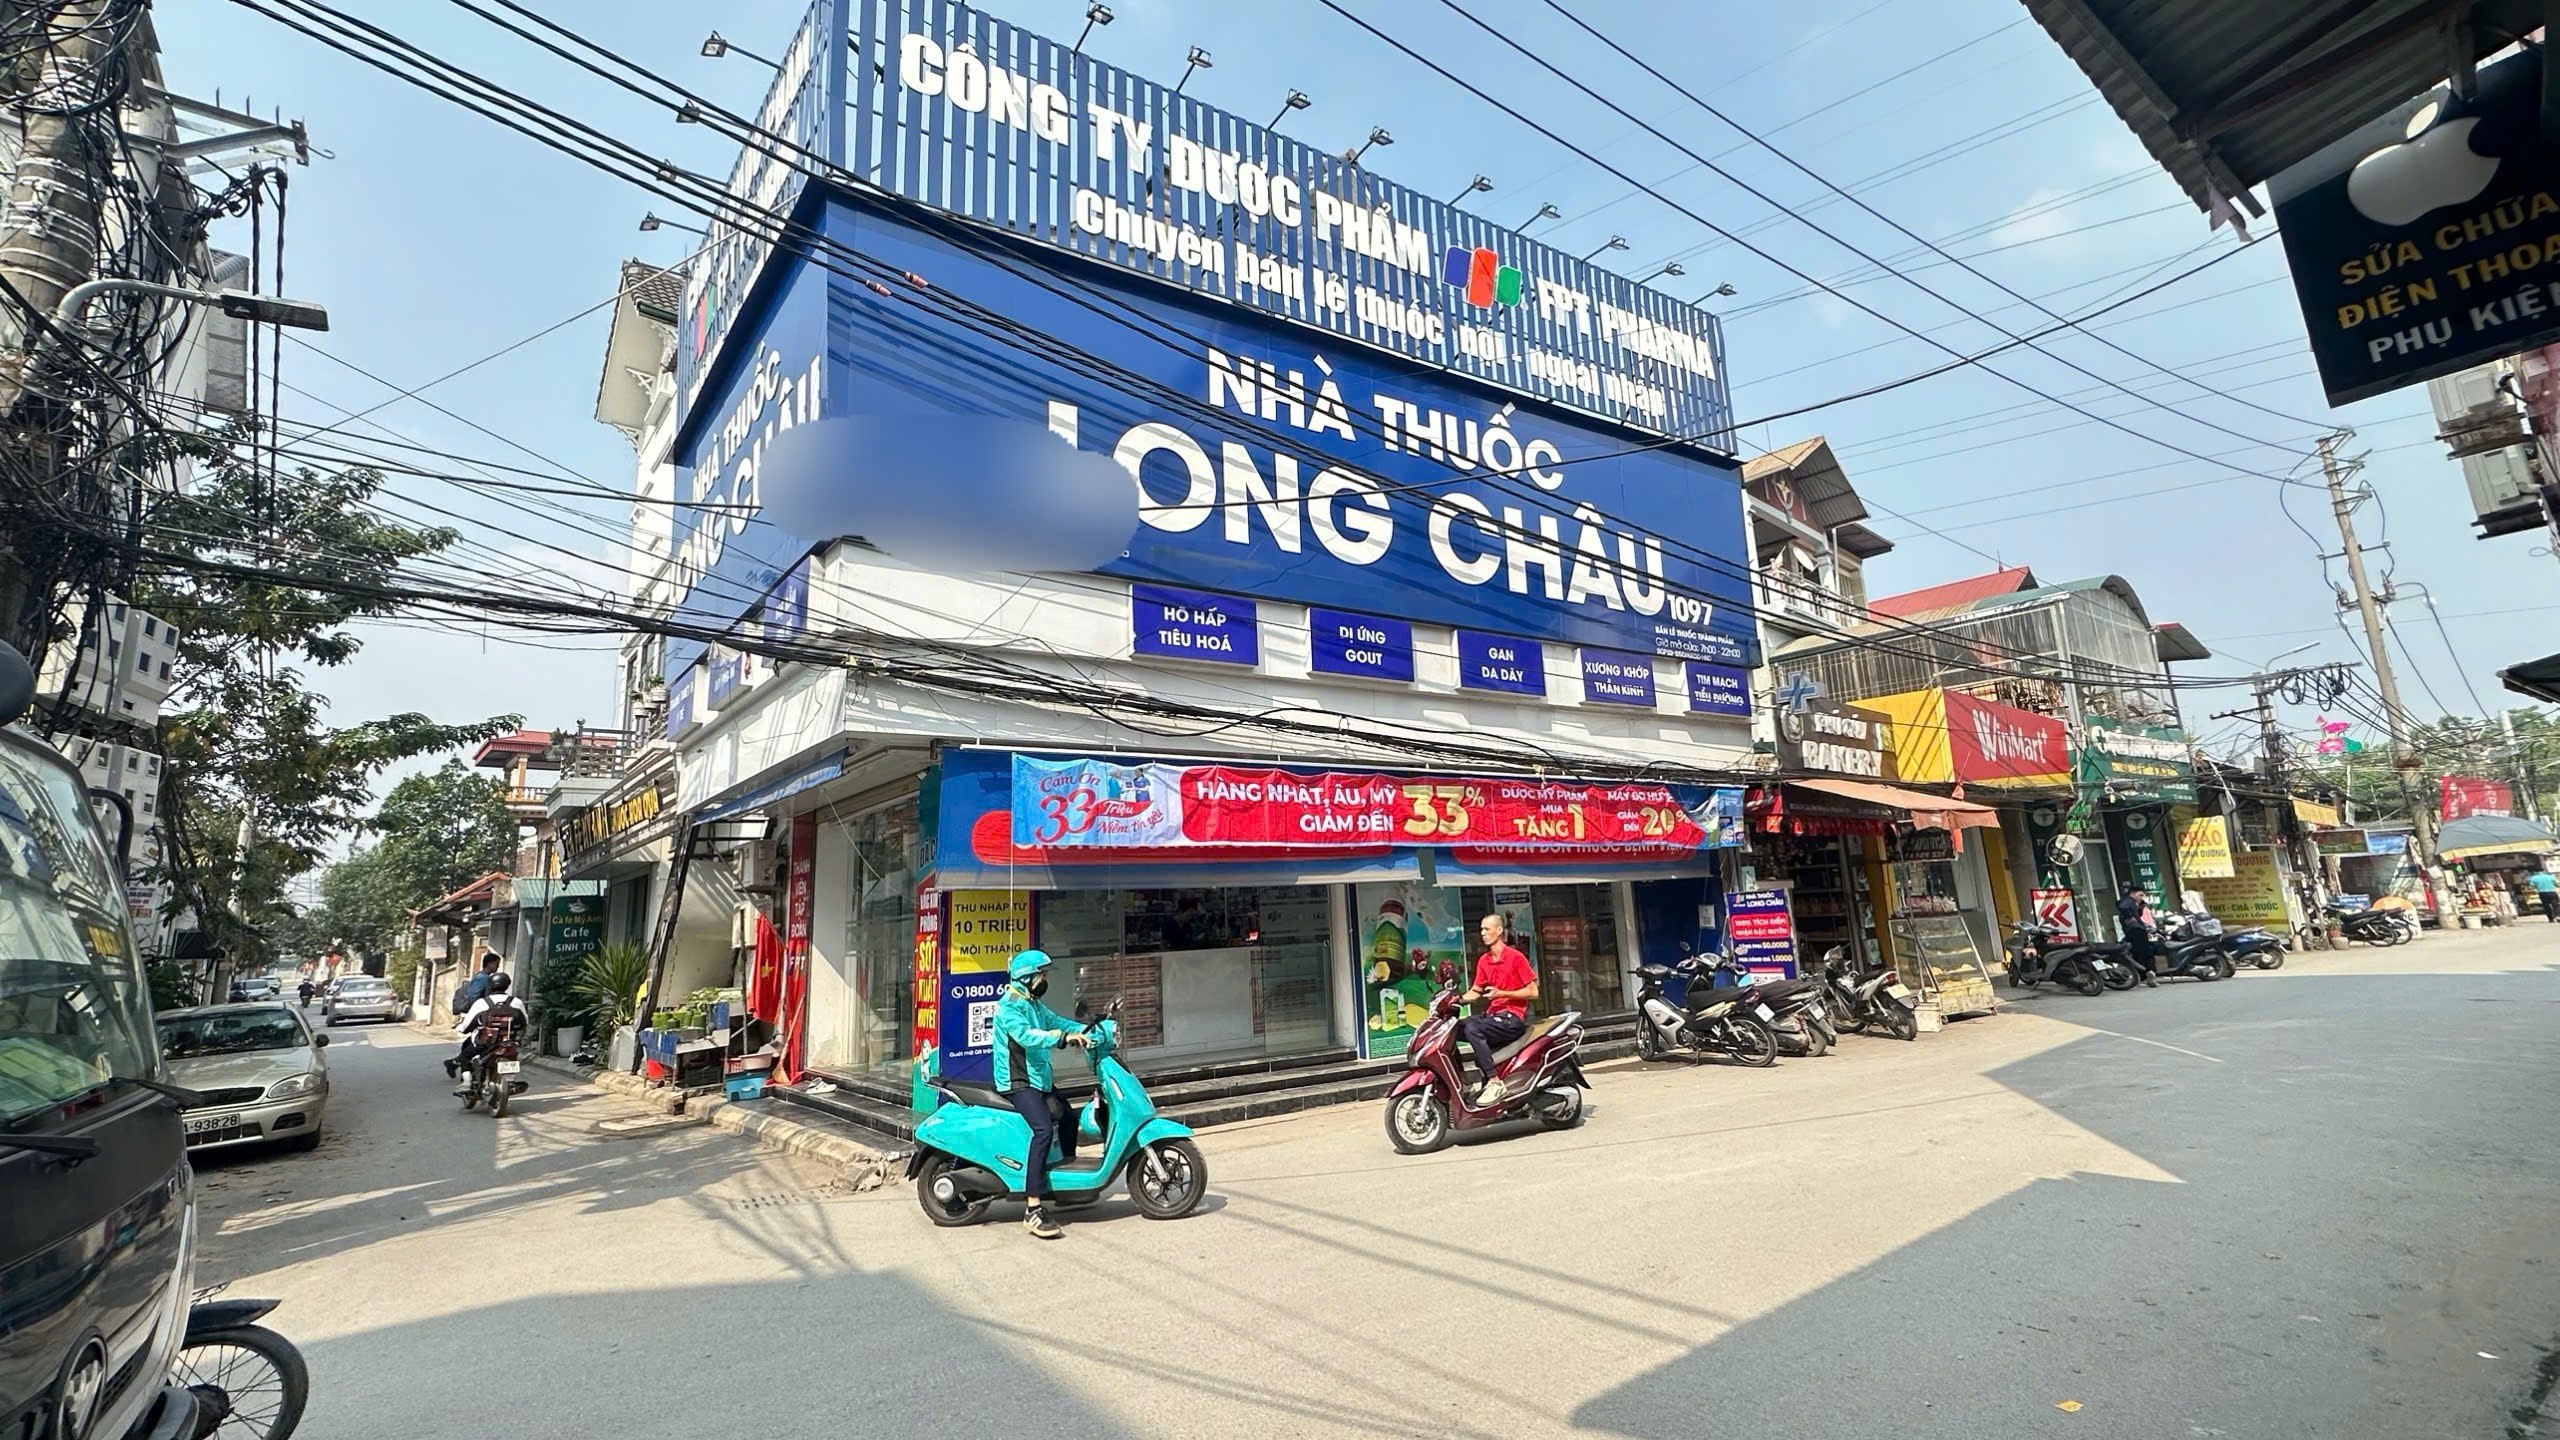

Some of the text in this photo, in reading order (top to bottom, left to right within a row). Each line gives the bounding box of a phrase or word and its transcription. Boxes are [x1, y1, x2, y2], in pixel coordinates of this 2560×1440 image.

[900, 33, 1431, 278] CÔNG TY DƯỢC PHẨM
[2339, 190, 2560, 286] SỬA CHỮA
[1076, 188, 1226, 274] Chuyên
[1235, 240, 1302, 299] bán
[1314, 263, 1348, 314] lẻ
[1355, 287, 1445, 346] thuốc
[1459, 324, 1504, 366] nội
[1529, 347, 1601, 397] ngoại
[1605, 369, 1664, 418] nhập
[2336, 277, 2438, 329] ĐIỆN
[1537, 276, 1717, 381] FPT PHARMA
[2367, 316, 2453, 364] PHỤ
[691, 340, 781, 511] NHÀ THUỐC
[1208, 346, 1565, 492] NHÀ THUỐC
[1048, 399, 1669, 618] ONG CHÂU
[1163, 606, 1228, 627] HÔ HẤP
[1666, 593, 1713, 626] 1097
[1158, 629, 1233, 652] TIÊU HOÁ
[1339, 625, 1386, 645] DỊ ỨNG
[1345, 650, 1383, 666] GOUT
[1488, 647, 1514, 662] GAN
[1584, 661, 1650, 680] XƯƠNG KHỚP
[1696, 673, 1739, 691] TIM MẠCH
[1802, 740, 1883, 777] BAKERY
[1198, 775, 1397, 809] HÀNG NHẬT, ÂU, MỸ
[1034, 788, 1135, 843] 33 Triệu
[1300, 808, 1394, 833] GIẢM ĐẾN
[1401, 785, 1485, 837] 33%
[1512, 803, 1585, 842] TẶNG 1
[1540, 804, 1564, 814] MUA
[1130, 821, 1147, 832] tin
[955, 904, 977, 912] THU
[1746, 899, 1765, 908] LONG
[1766, 897, 1784, 906] CHÂU
[954, 920, 973, 934] 10
[555, 943, 578, 952] SINH
[919, 933, 938, 973] SỐT
[984, 942, 1022, 954] THÁNG
[965, 985, 994, 998] 1800
